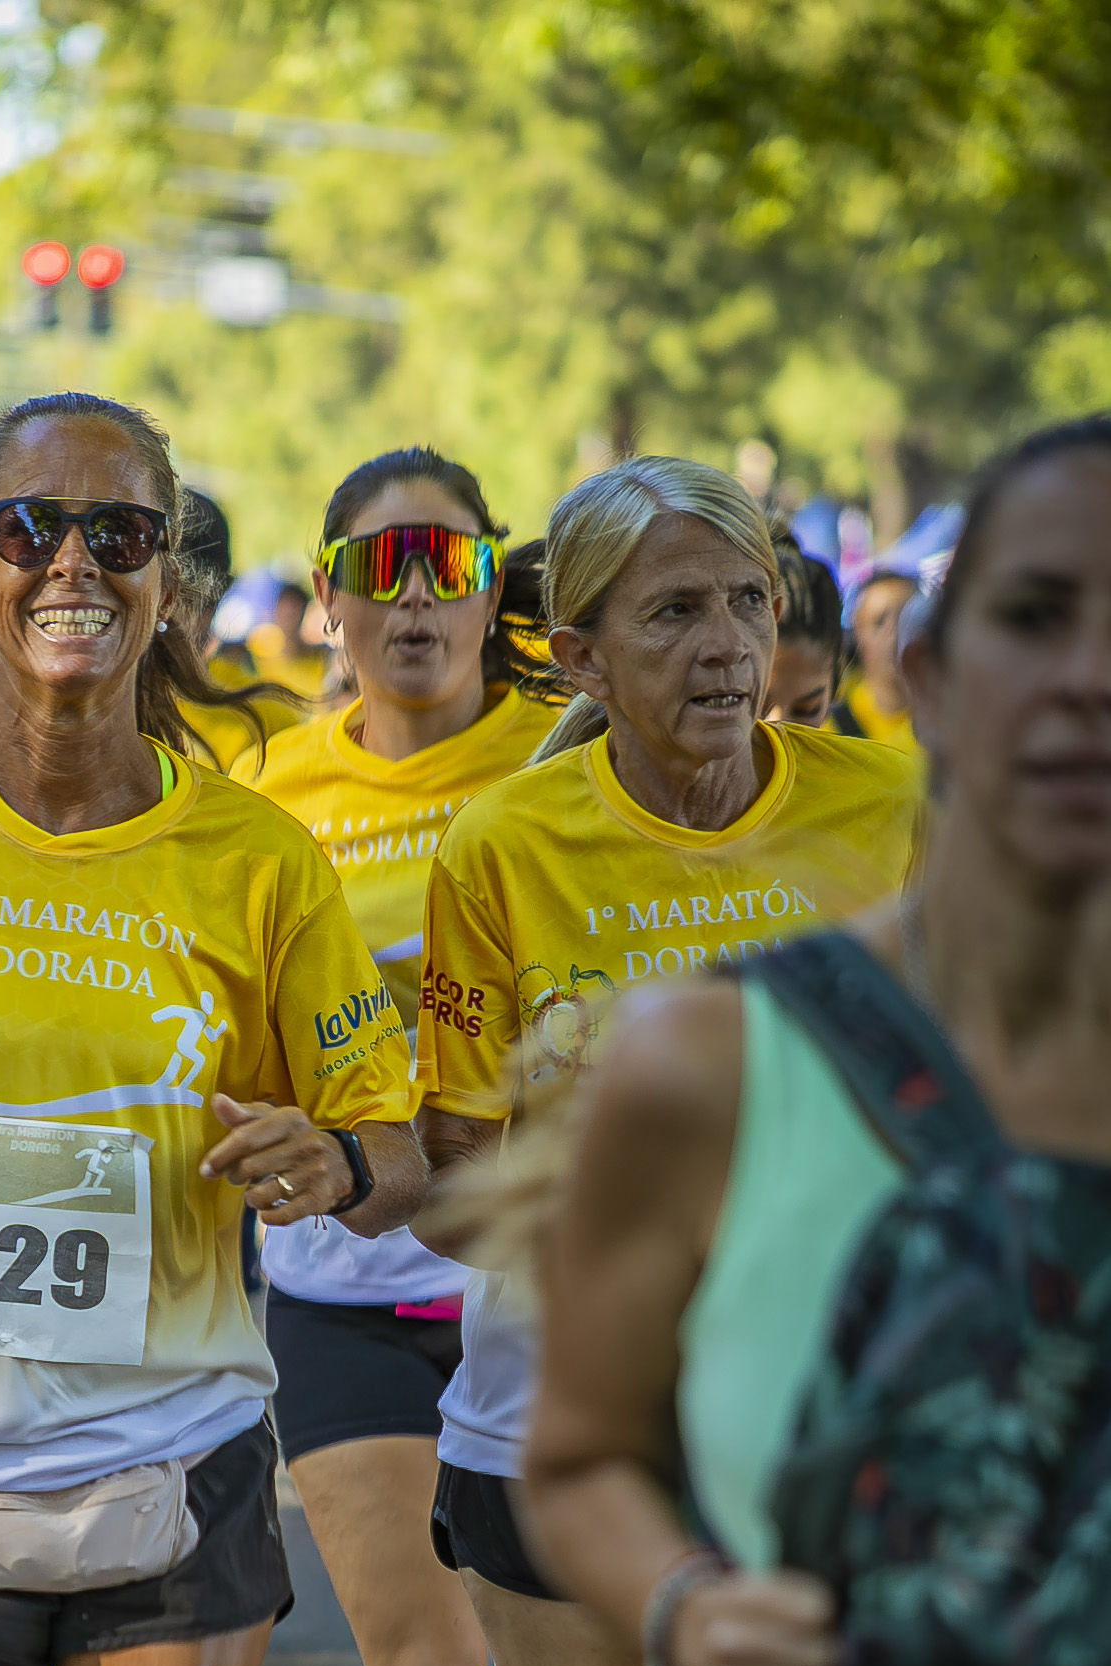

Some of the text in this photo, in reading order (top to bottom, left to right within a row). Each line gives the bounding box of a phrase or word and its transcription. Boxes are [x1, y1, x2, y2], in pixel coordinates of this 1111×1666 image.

[626, 879, 817, 932] MARATÓN
[313, 1047, 366, 1080] SABORES
[10, 1138, 61, 1155] DORADA
